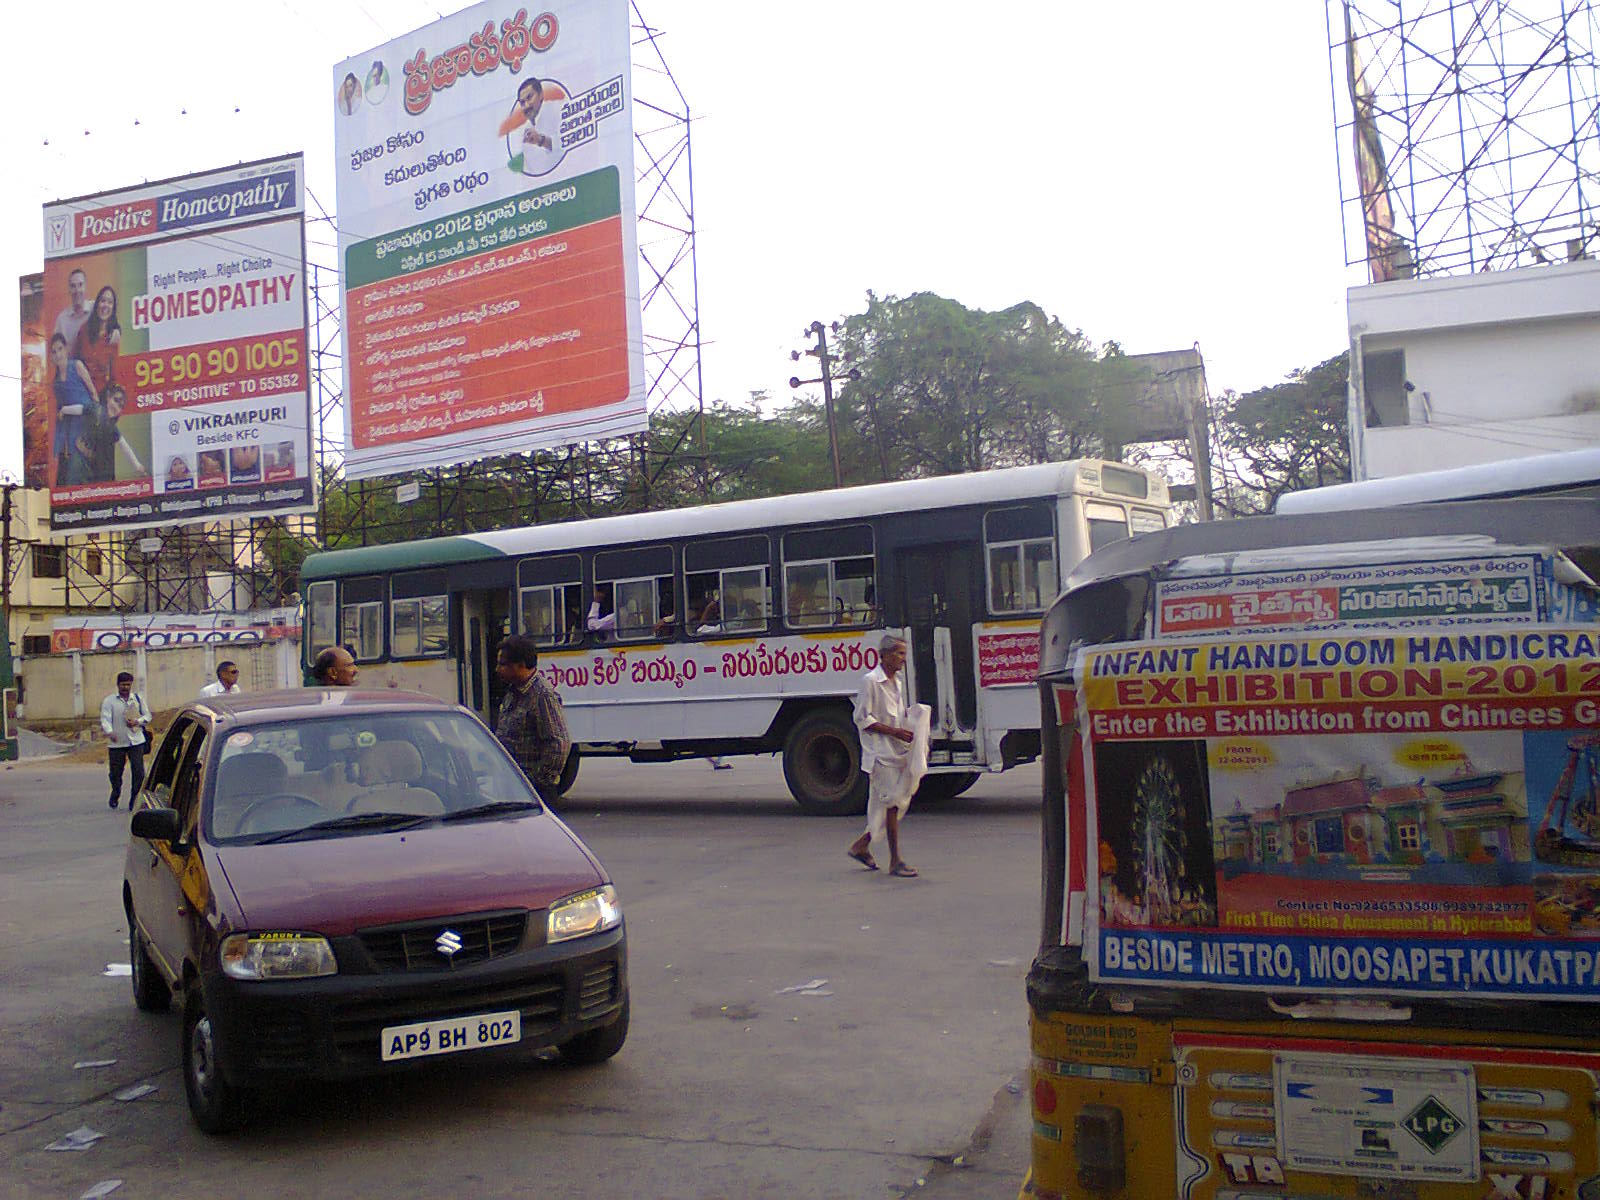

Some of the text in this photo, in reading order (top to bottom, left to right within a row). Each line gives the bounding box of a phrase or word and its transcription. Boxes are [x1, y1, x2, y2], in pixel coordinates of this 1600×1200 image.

[351, 130, 425, 172] ప్రజల కోసం
[384, 147, 468, 186] కదులుతోంది
[80, 177, 290, 239] Positive Homeopathy
[414, 181, 451, 212] ప్రగతి
[434, 215, 472, 240] 2012
[153, 273, 176, 289] Right
[242, 256, 273, 273] Choice
[134, 273, 296, 326] HOMEOPATHY
[135, 337, 299, 388] 92 90 90 1005
[137, 392, 164, 408] SMS
[240, 379, 256, 394] TO
[184, 406, 287, 432] VIKRAMPURI
[197, 428, 260, 446] Beside KFC
[593, 651, 627, 685] కిలో
[631, 655, 697, 688] బియ్యం
[722, 643, 828, 678] నిరుపేదలకు
[831, 642, 879, 672] వరం
[1093, 633, 1600, 677] INFANT HANDLOOM HANDICRA
[1116, 661, 1600, 706] EXHIBITION-2012
[1094, 699, 1600, 736] Enter the Exhibition from Chinees G
[1277, 898, 1329, 911] Contact
[1226, 911, 1532, 936] First Time China Amusement in Hyderabad
[1105, 936, 1194, 974] BESIDE
[1201, 941, 1302, 986] METRO,
[390, 1020, 513, 1055] AP9 BH 802
[1412, 1115, 1455, 1134] LPG
